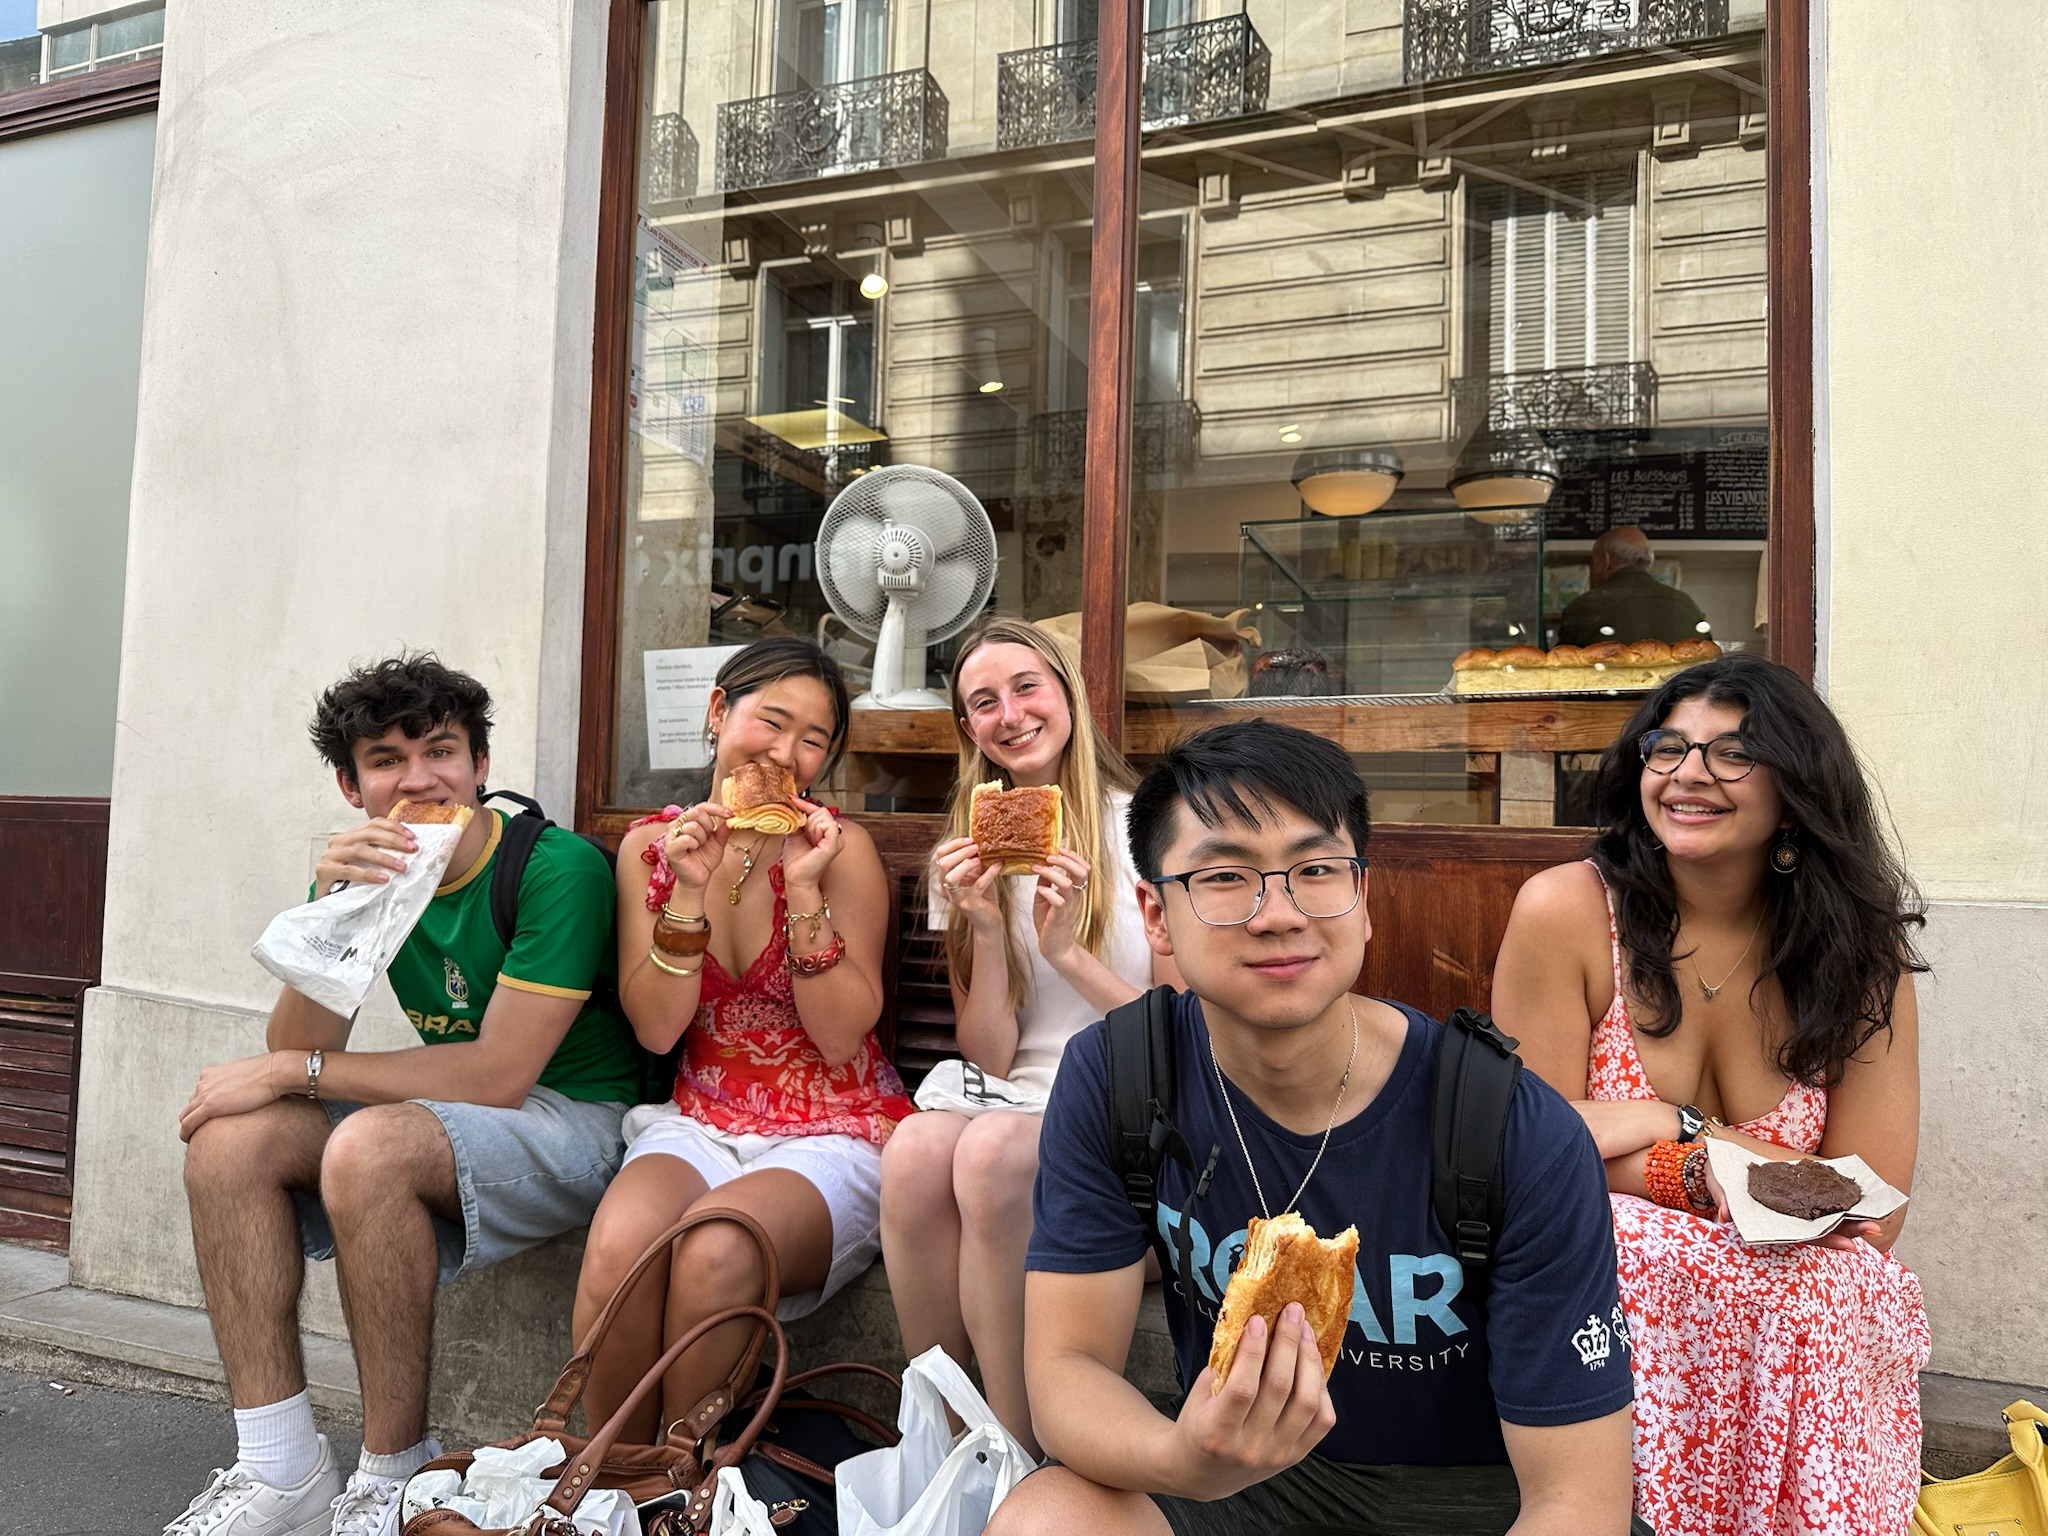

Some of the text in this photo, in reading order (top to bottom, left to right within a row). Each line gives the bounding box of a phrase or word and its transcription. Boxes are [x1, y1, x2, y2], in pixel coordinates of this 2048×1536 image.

[1610, 469, 1688, 483] LES BOISSONS
[1705, 490, 1722, 505] LES
[407, 1010, 477, 1035] BRA
[1340, 1342, 1470, 1372] IVERSITY
